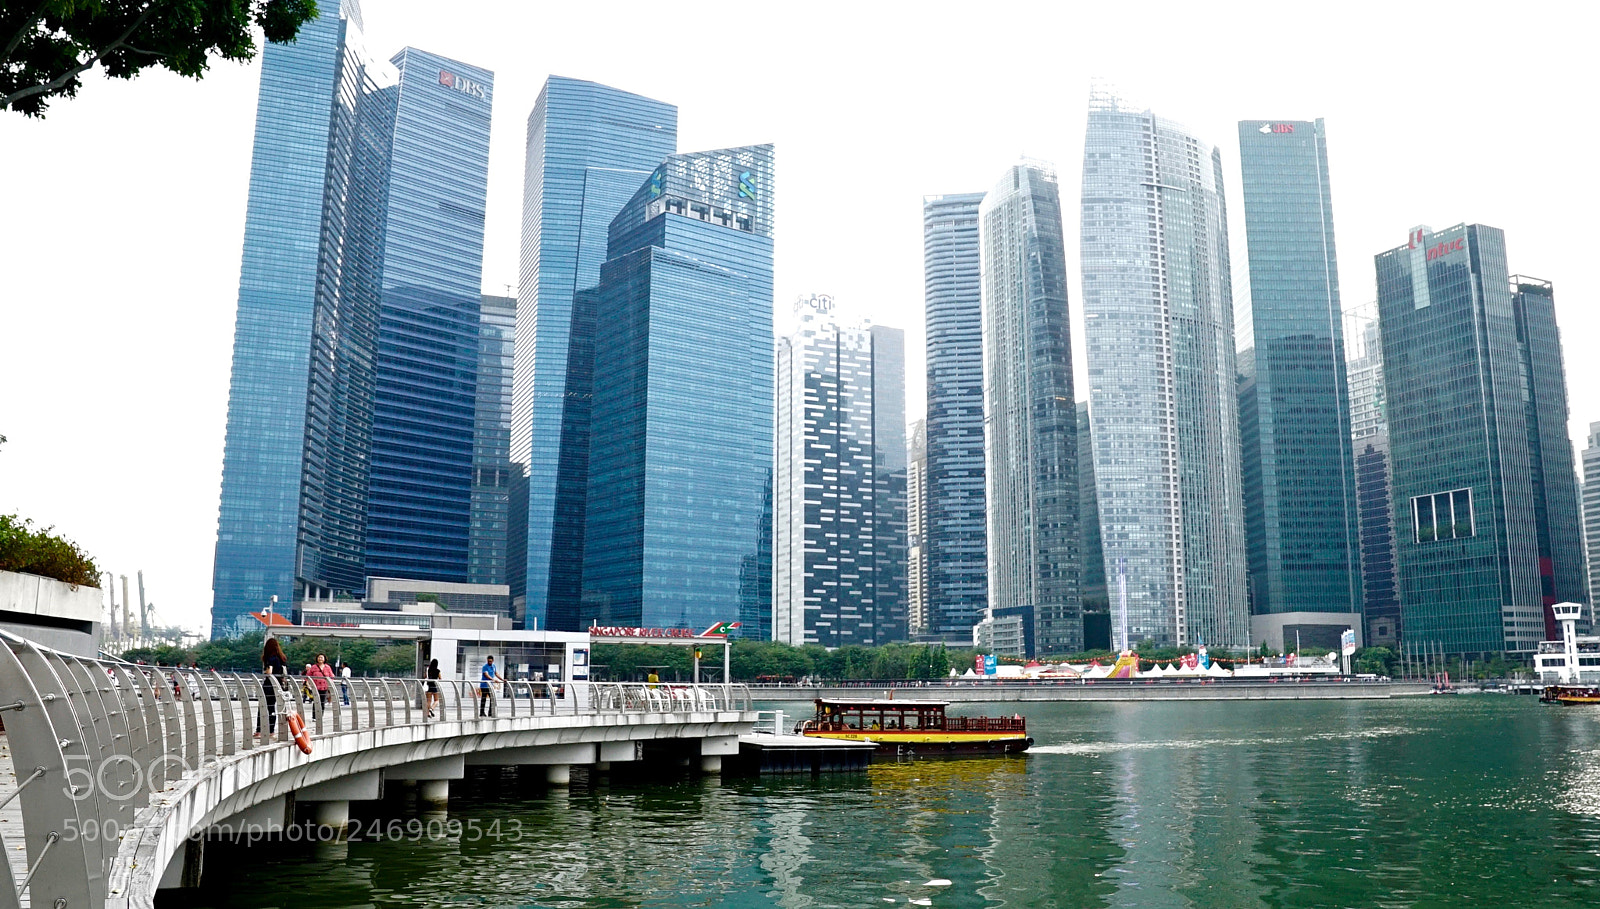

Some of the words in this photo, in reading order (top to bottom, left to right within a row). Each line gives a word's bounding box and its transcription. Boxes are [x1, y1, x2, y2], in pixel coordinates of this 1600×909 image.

[455, 76, 485, 98] DBS
[1272, 123, 1294, 133] UBS
[1427, 238, 1464, 261] ntuc
[810, 295, 831, 310] citi
[589, 626, 637, 637] SINGAPORE
[639, 627, 663, 637] RIVER
